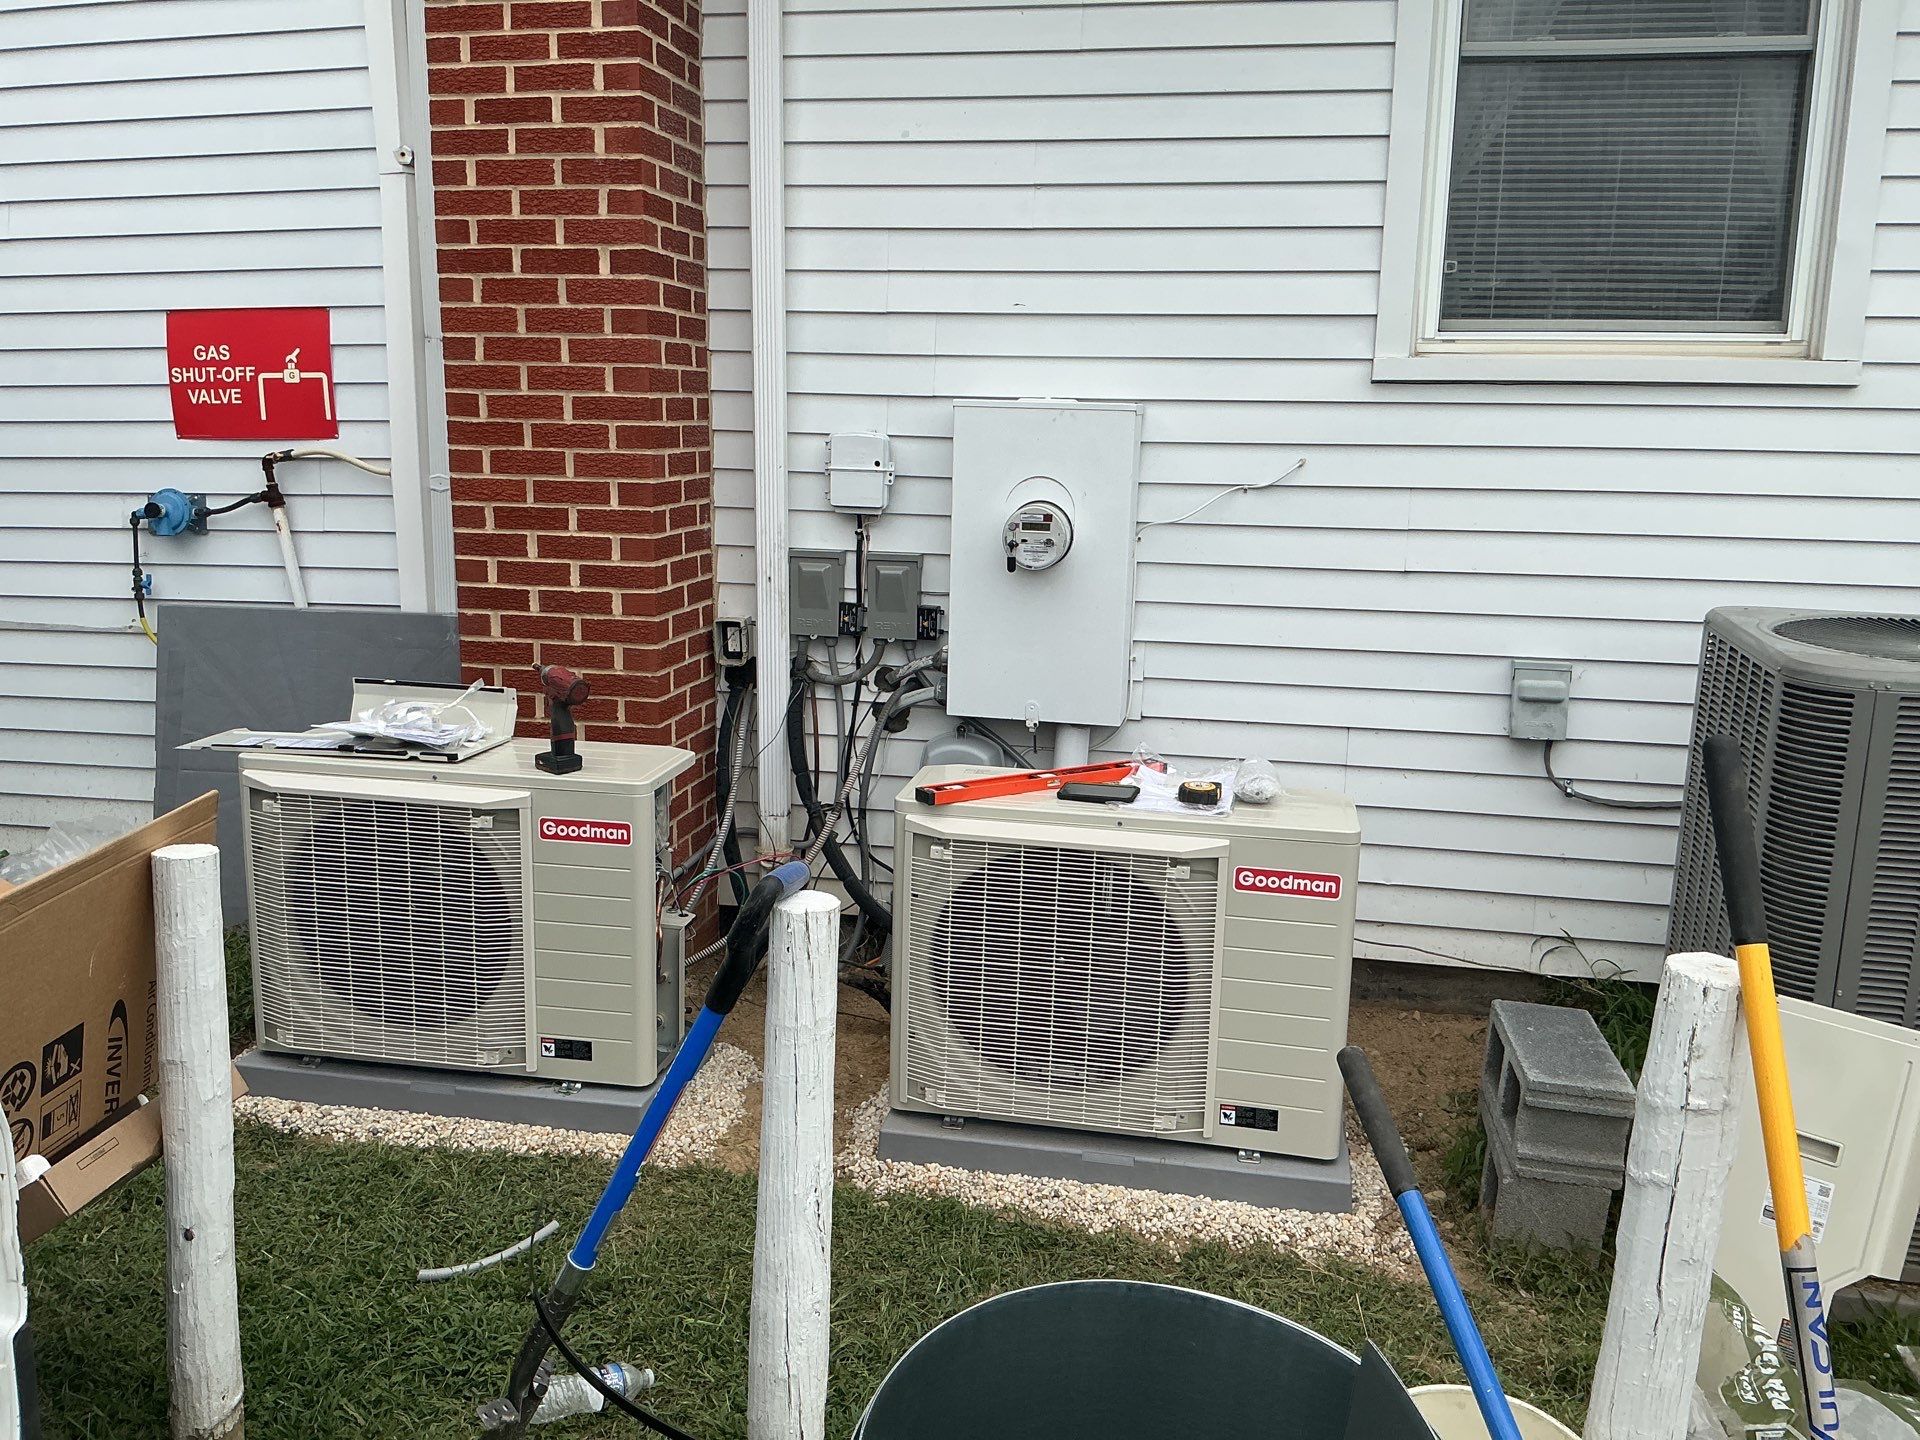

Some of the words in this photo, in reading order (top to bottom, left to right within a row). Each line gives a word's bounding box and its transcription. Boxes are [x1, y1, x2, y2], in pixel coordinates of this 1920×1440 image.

[193, 344, 230, 361] GAS
[171, 366, 256, 383] SHUT-OFF
[289, 371, 295, 379] G
[187, 388, 242, 404] VALVE
[542, 821, 628, 840] Goodman
[1238, 870, 1337, 893] Goodman
[147, 980, 157, 1000] Air
